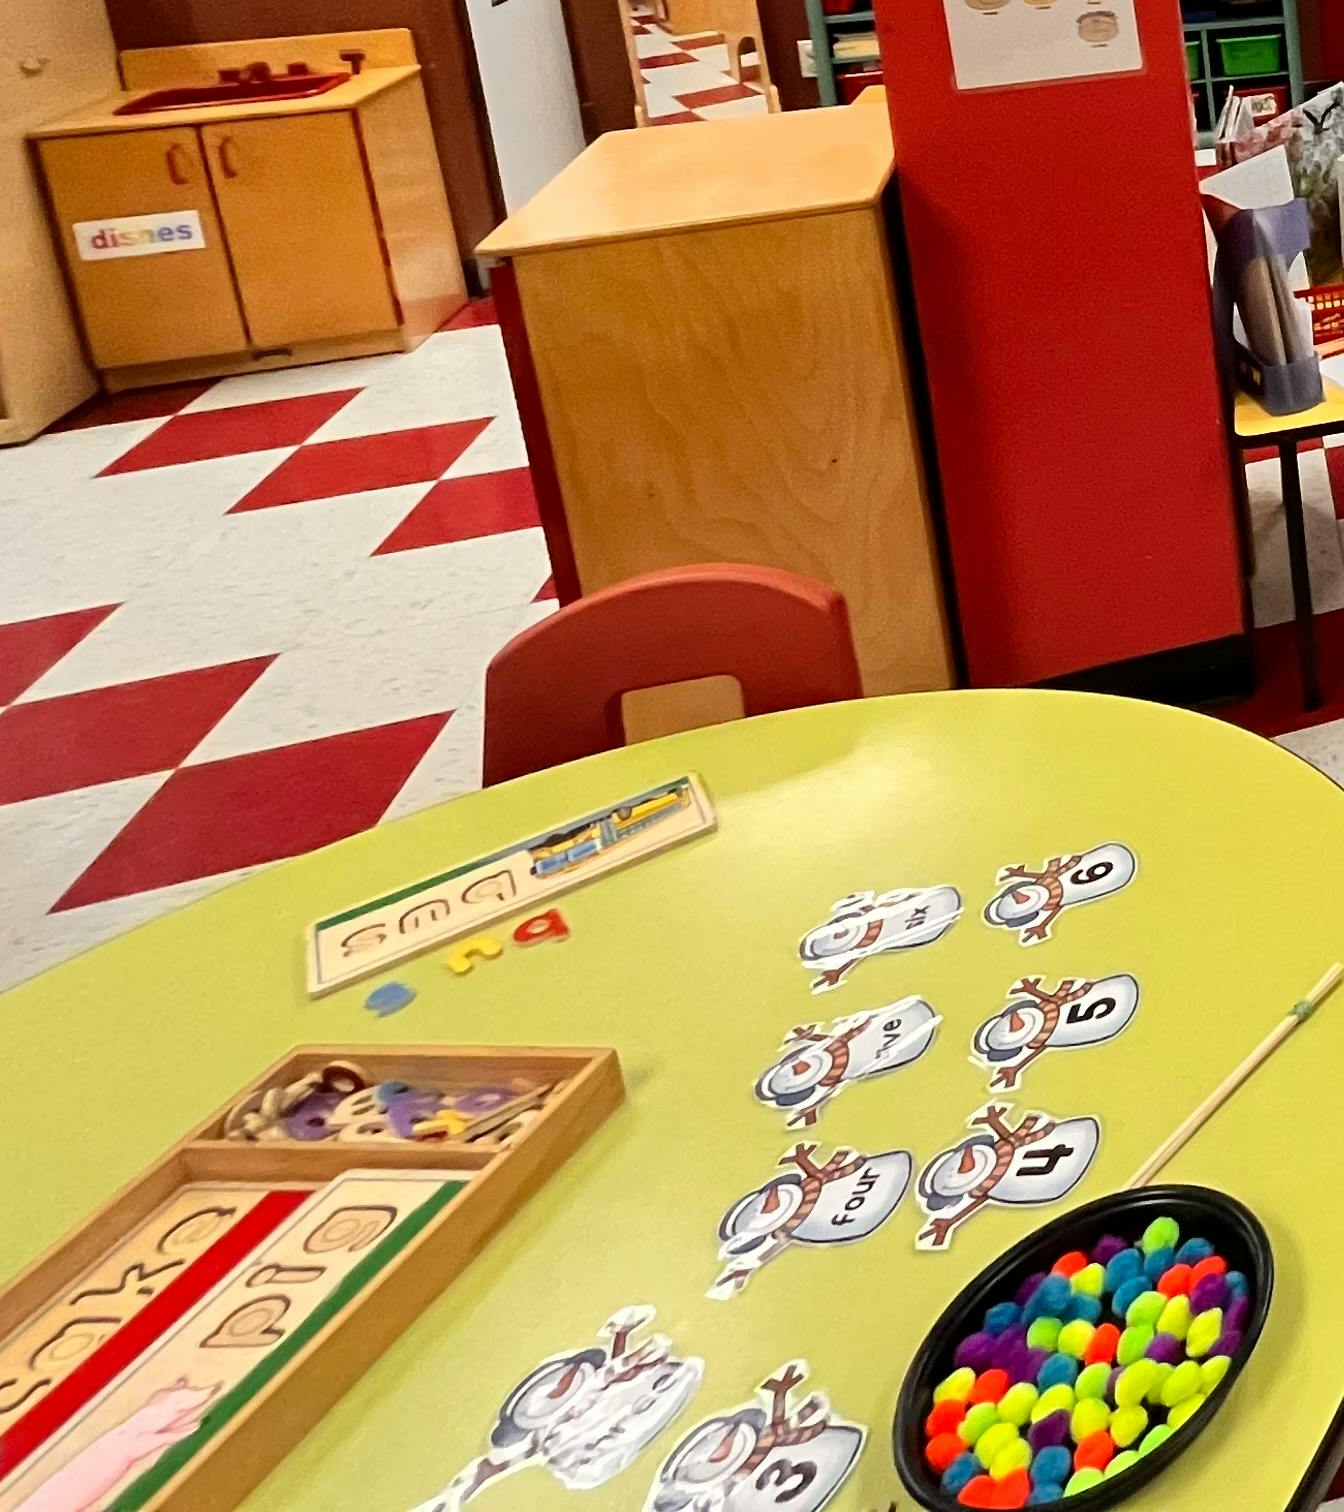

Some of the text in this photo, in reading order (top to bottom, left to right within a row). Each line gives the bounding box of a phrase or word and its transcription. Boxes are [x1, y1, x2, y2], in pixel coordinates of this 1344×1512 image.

[1071, 861, 1114, 885] 6
[905, 904, 930, 931] six
[1066, 997, 1117, 1025] 5
[1015, 1144, 1075, 1177] 4
[831, 1167, 881, 1227] four
[199, 1204, 398, 1349] pig
[755, 1458, 818, 1504] 3
